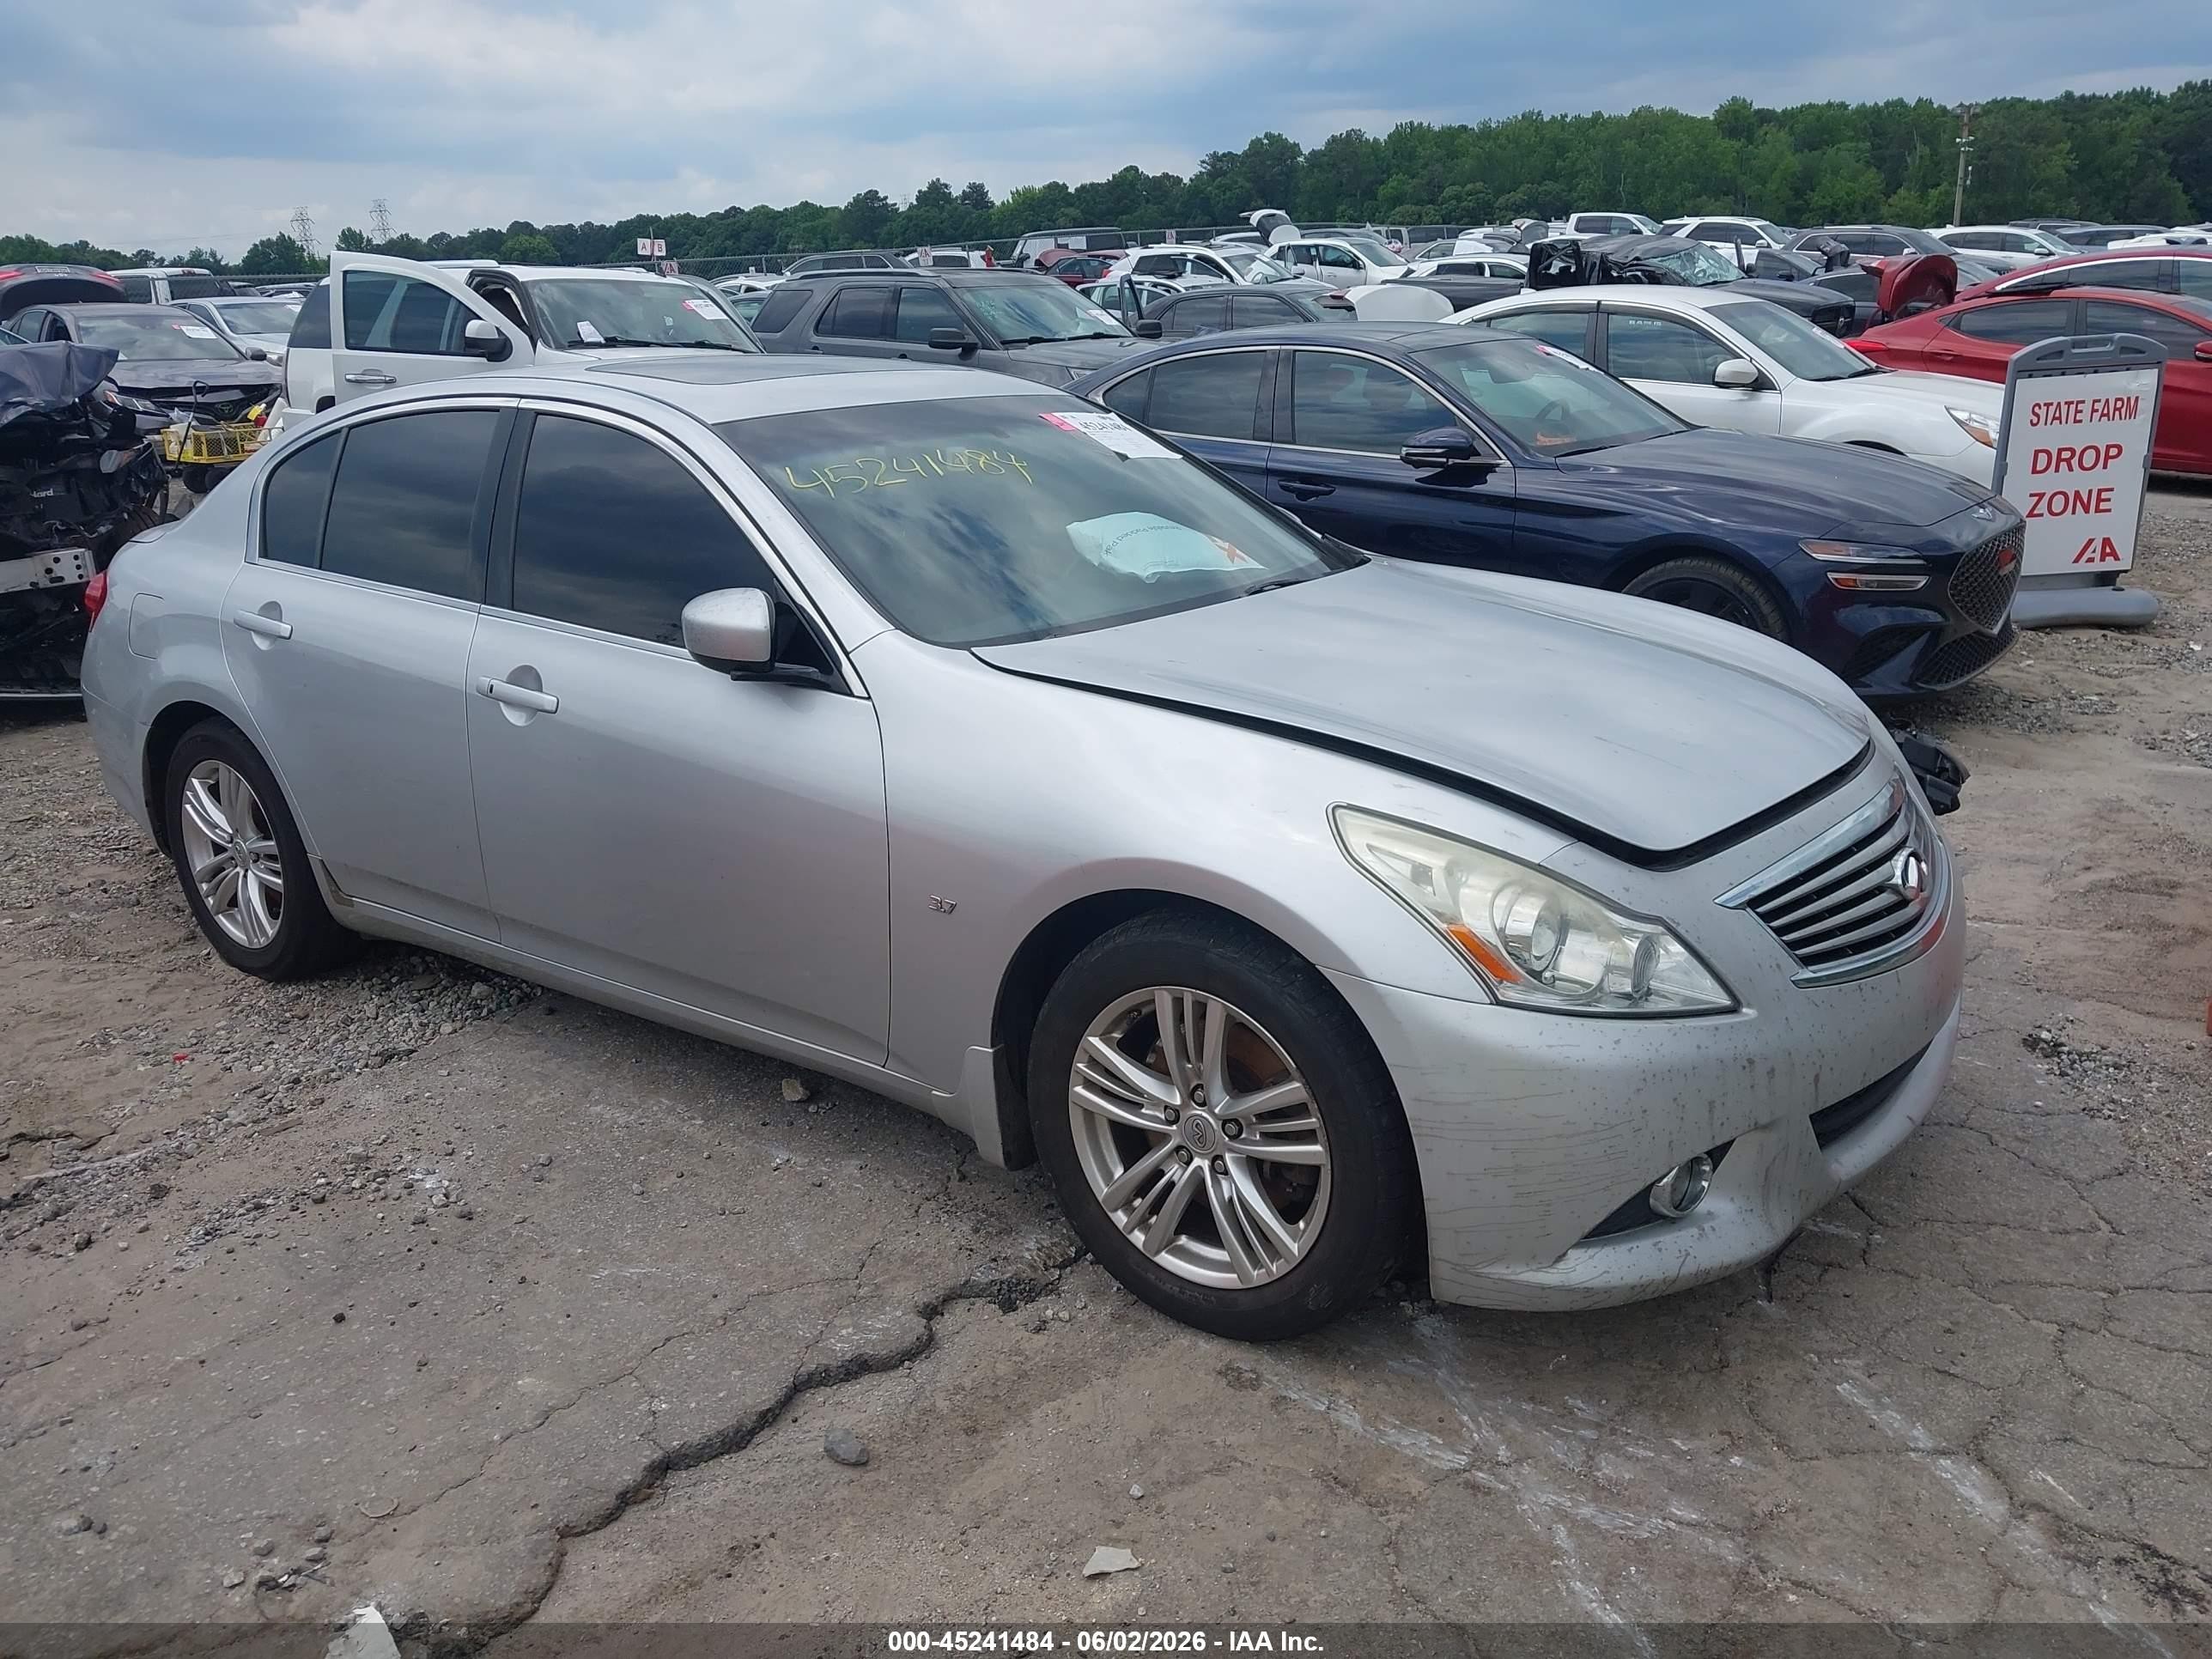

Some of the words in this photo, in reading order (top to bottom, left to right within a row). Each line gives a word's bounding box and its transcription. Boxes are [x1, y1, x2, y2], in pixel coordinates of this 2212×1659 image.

[641, 241, 647, 252] A
[657, 243, 663, 252] B
[2029, 399, 2086, 427] STATE
[2089, 396, 2139, 423] FARM
[785, 449, 1033, 500] 45241484
[2031, 443, 2124, 475] DROP
[2025, 487, 2115, 519] ZONE
